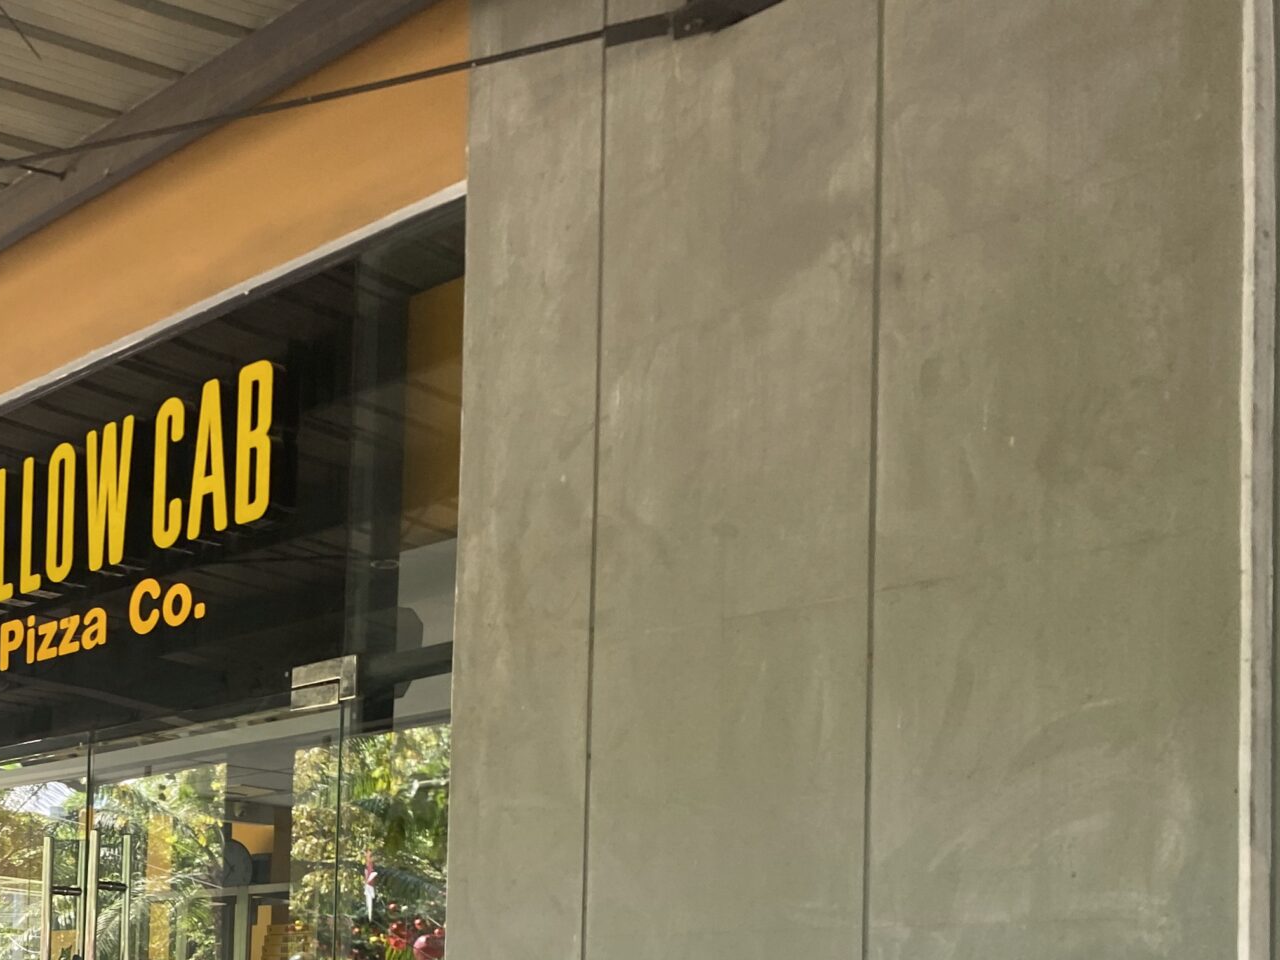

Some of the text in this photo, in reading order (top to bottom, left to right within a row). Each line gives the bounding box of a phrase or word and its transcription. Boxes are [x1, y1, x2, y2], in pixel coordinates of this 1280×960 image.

[151, 360, 274, 549] CAB
[0, 577, 206, 672] Pizza Co.
